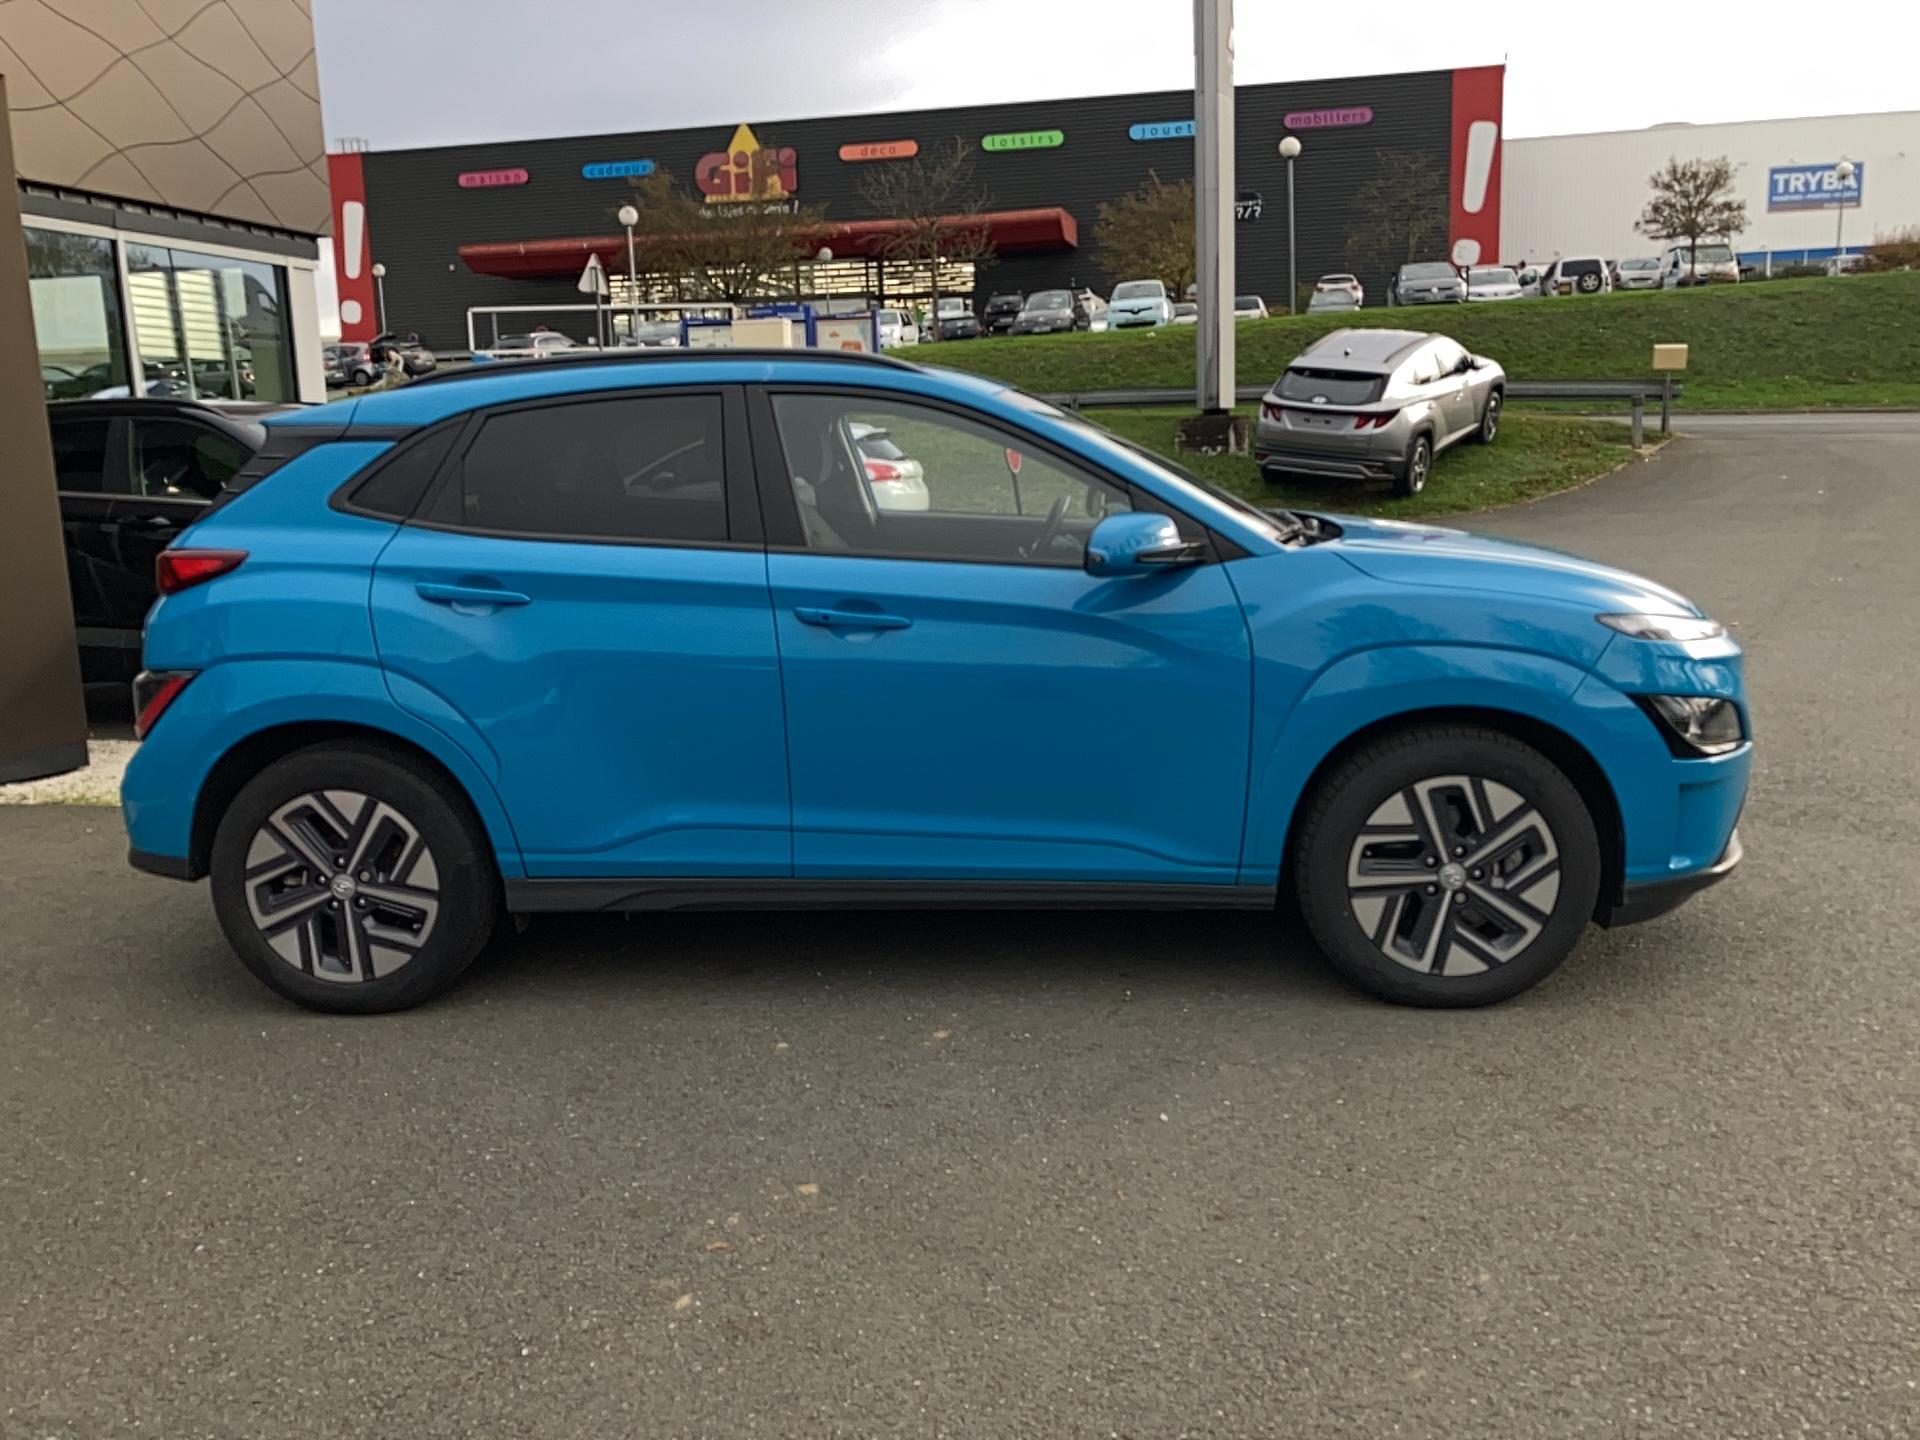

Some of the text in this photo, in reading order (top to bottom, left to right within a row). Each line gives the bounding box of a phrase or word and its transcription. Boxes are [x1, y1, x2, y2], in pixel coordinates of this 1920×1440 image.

[1290, 111, 1366, 126] mobiliers
[1139, 123, 1193, 139] jouet
[991, 133, 1055, 148] loisirs
[465, 172, 521, 185] maison
[1772, 170, 1858, 194] TRYBA
